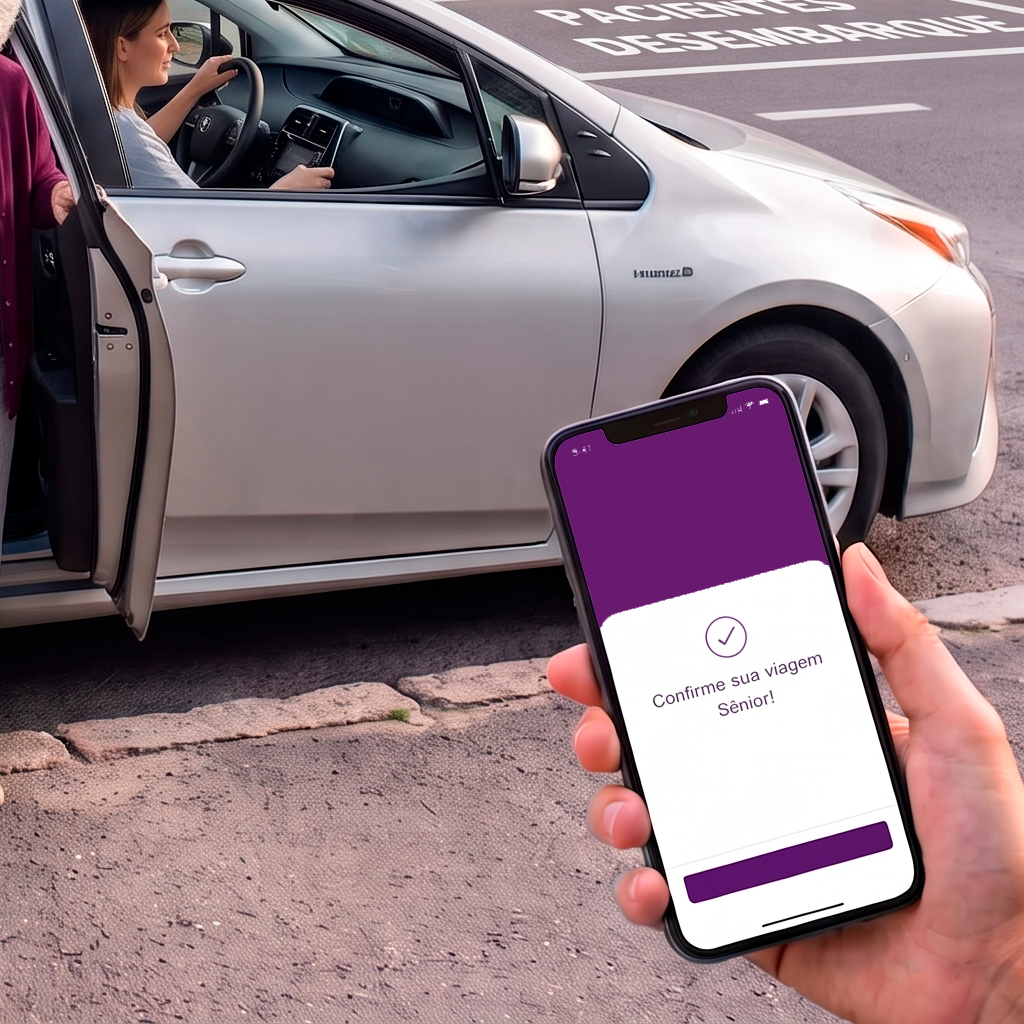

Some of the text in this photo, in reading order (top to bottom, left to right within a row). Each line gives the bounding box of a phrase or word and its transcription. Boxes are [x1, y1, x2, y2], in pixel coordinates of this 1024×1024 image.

[572, 14, 1024, 57] DESEMBARQUE
[652, 654, 823, 708] Confirme sua viagem
[717, 689, 776, 717] Sênior!
